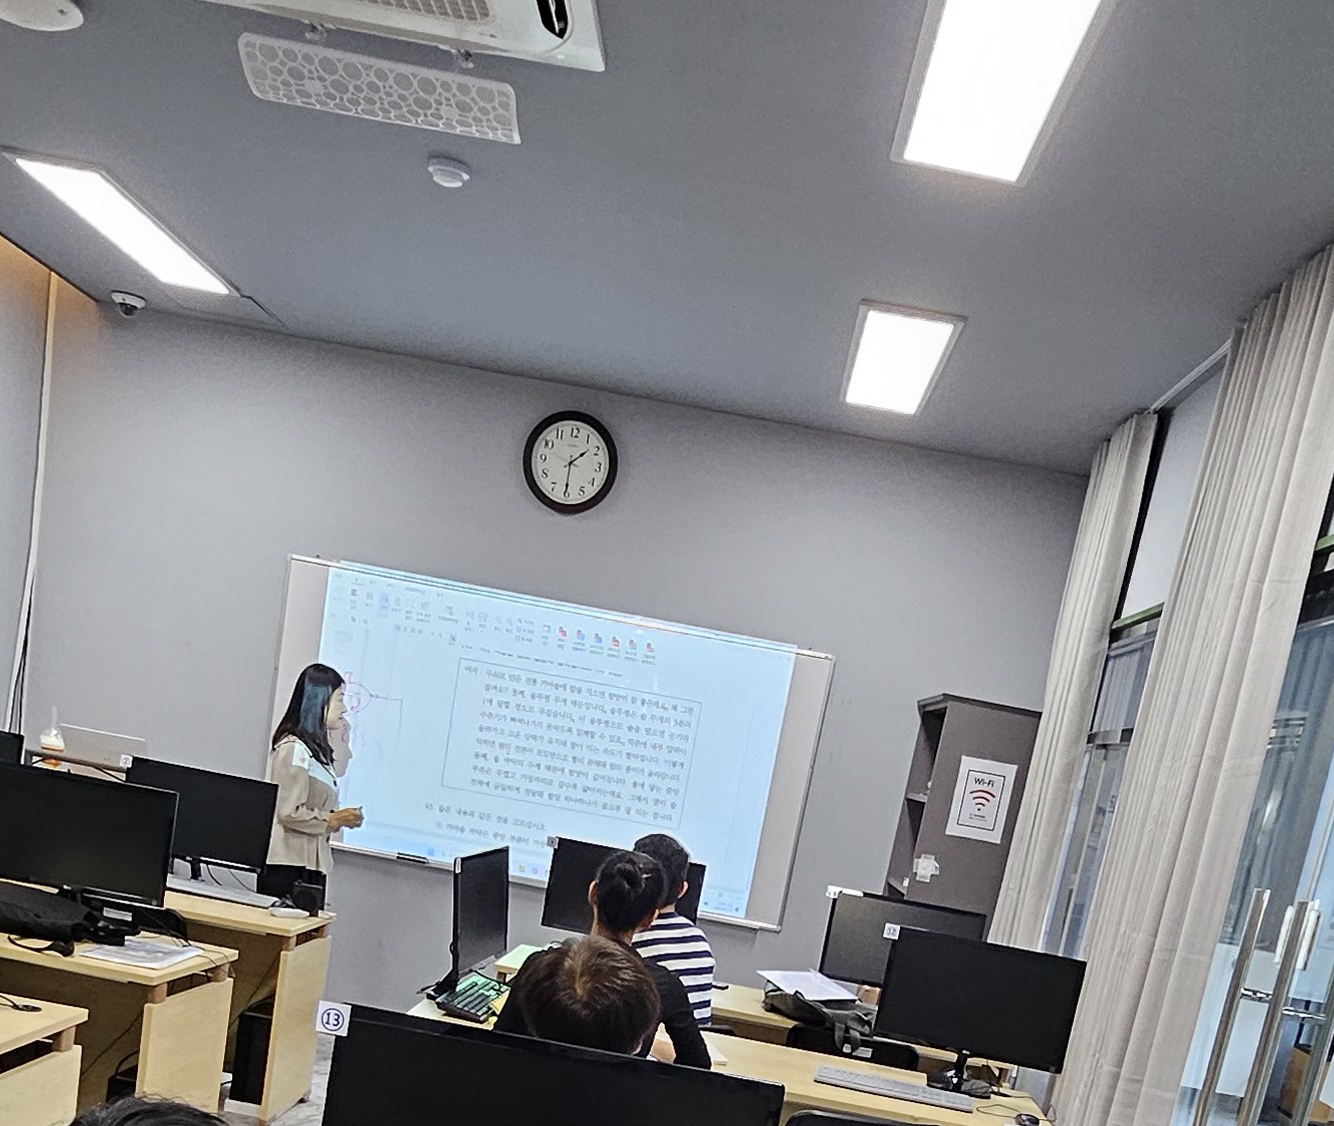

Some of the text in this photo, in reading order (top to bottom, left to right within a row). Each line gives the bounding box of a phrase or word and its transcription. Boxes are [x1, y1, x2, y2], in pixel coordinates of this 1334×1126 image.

[555, 426, 565, 440] 11
[570, 427, 581, 439] 12
[544, 438, 555, 450] 10
[586, 433, 591, 445] 1
[593, 445, 600, 456] 2
[540, 453, 547, 463] 9
[594, 462, 602, 473] 3
[541, 468, 548, 479] 8
[551, 481, 557, 492] 7
[588, 477, 595, 487] 4
[563, 489, 571, 499] 6
[578, 486, 585, 497] 5
[974, 777, 995, 787] Wi-Fi
[325, 1012, 340, 1027] 13
